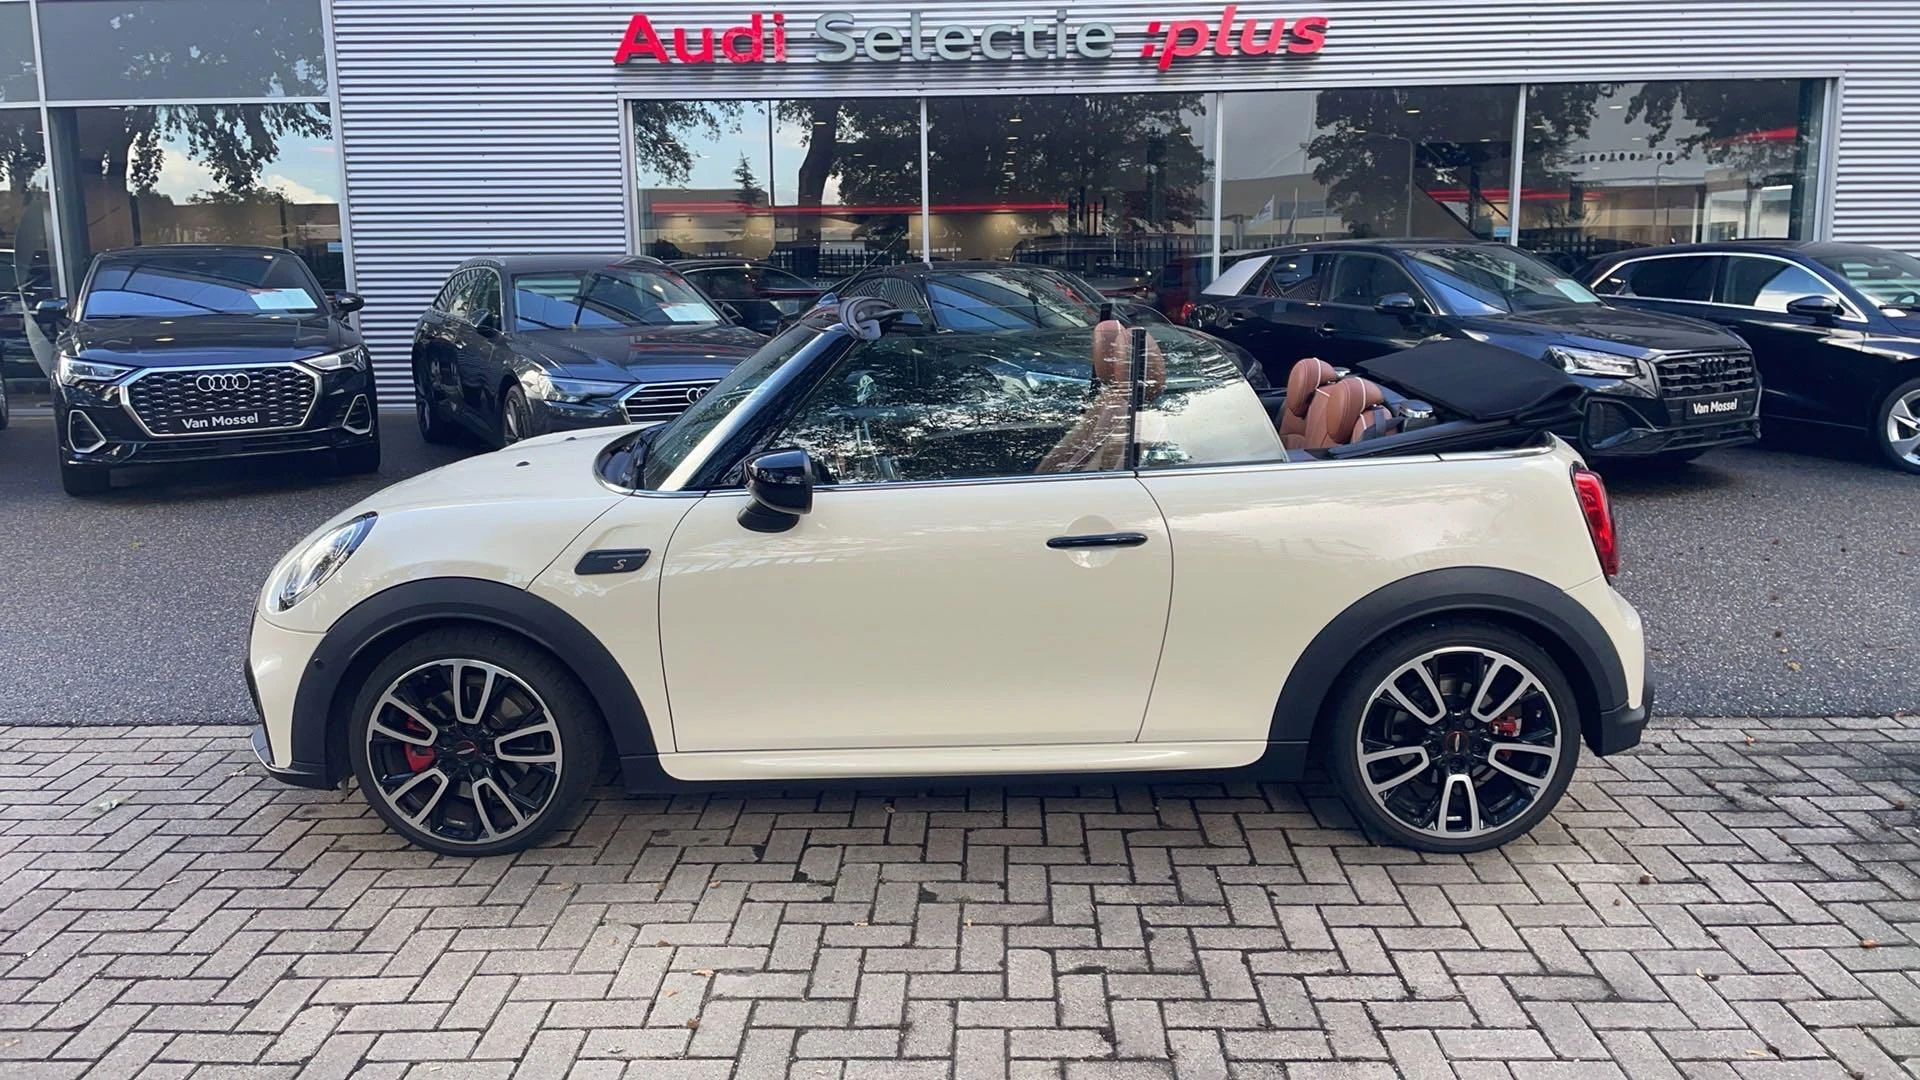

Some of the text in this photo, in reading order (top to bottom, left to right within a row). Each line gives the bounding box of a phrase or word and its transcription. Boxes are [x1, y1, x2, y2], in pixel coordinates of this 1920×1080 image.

[613, 12, 788, 63] Audi
[815, 10, 1116, 63] Selectie
[1693, 398, 1738, 414] Van Mossel
[181, 412, 259, 429] Van Mossel
[612, 559, 627, 571] S
